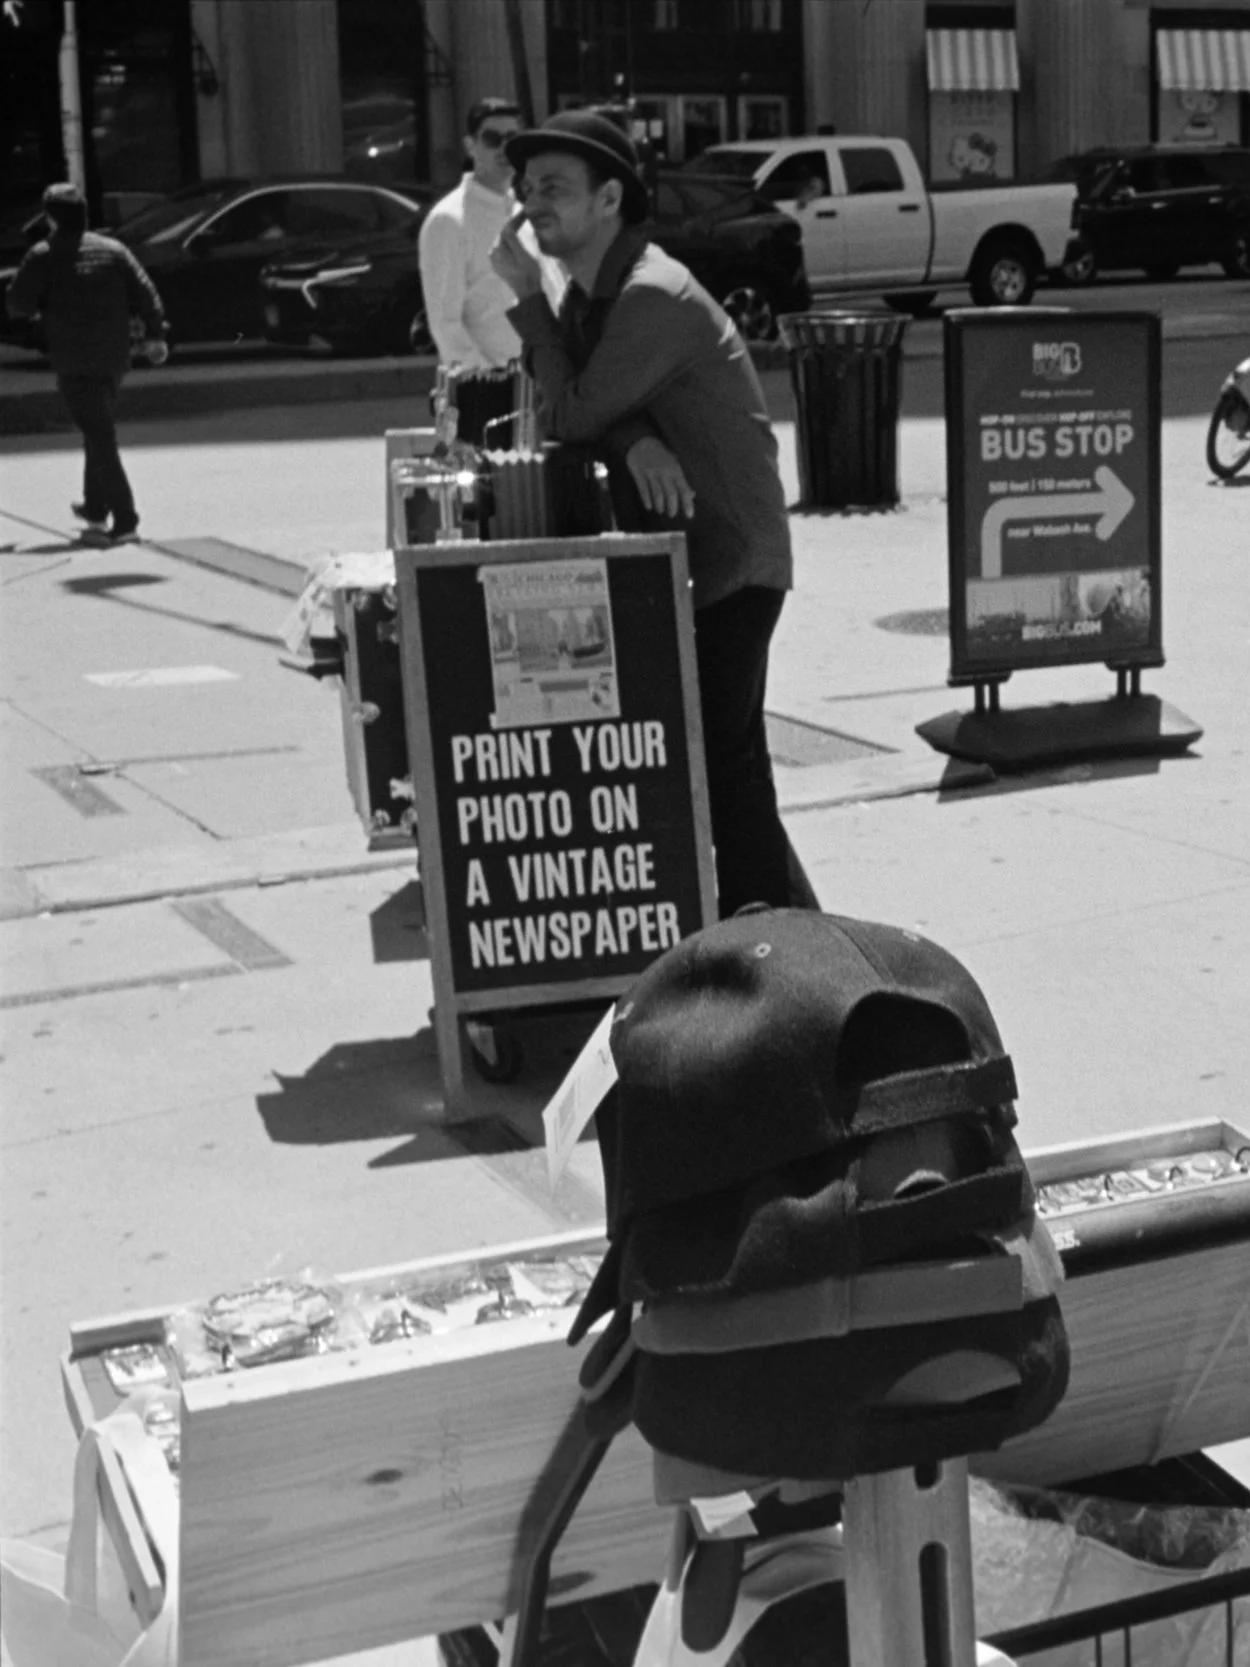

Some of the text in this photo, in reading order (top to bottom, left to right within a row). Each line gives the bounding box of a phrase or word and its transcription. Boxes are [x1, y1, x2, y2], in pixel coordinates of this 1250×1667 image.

[980, 423, 1134, 461] BUS STOP
[1056, 478, 1092, 490] meters
[1007, 527, 1031, 539] near
[1032, 524, 1071, 537] Wabash
[451, 721, 667, 783] PRINT YOUR
[457, 784, 639, 845] PHOTO ON
[466, 843, 656, 907] A VINTAGE
[468, 902, 681, 968] NEWSPAPER
